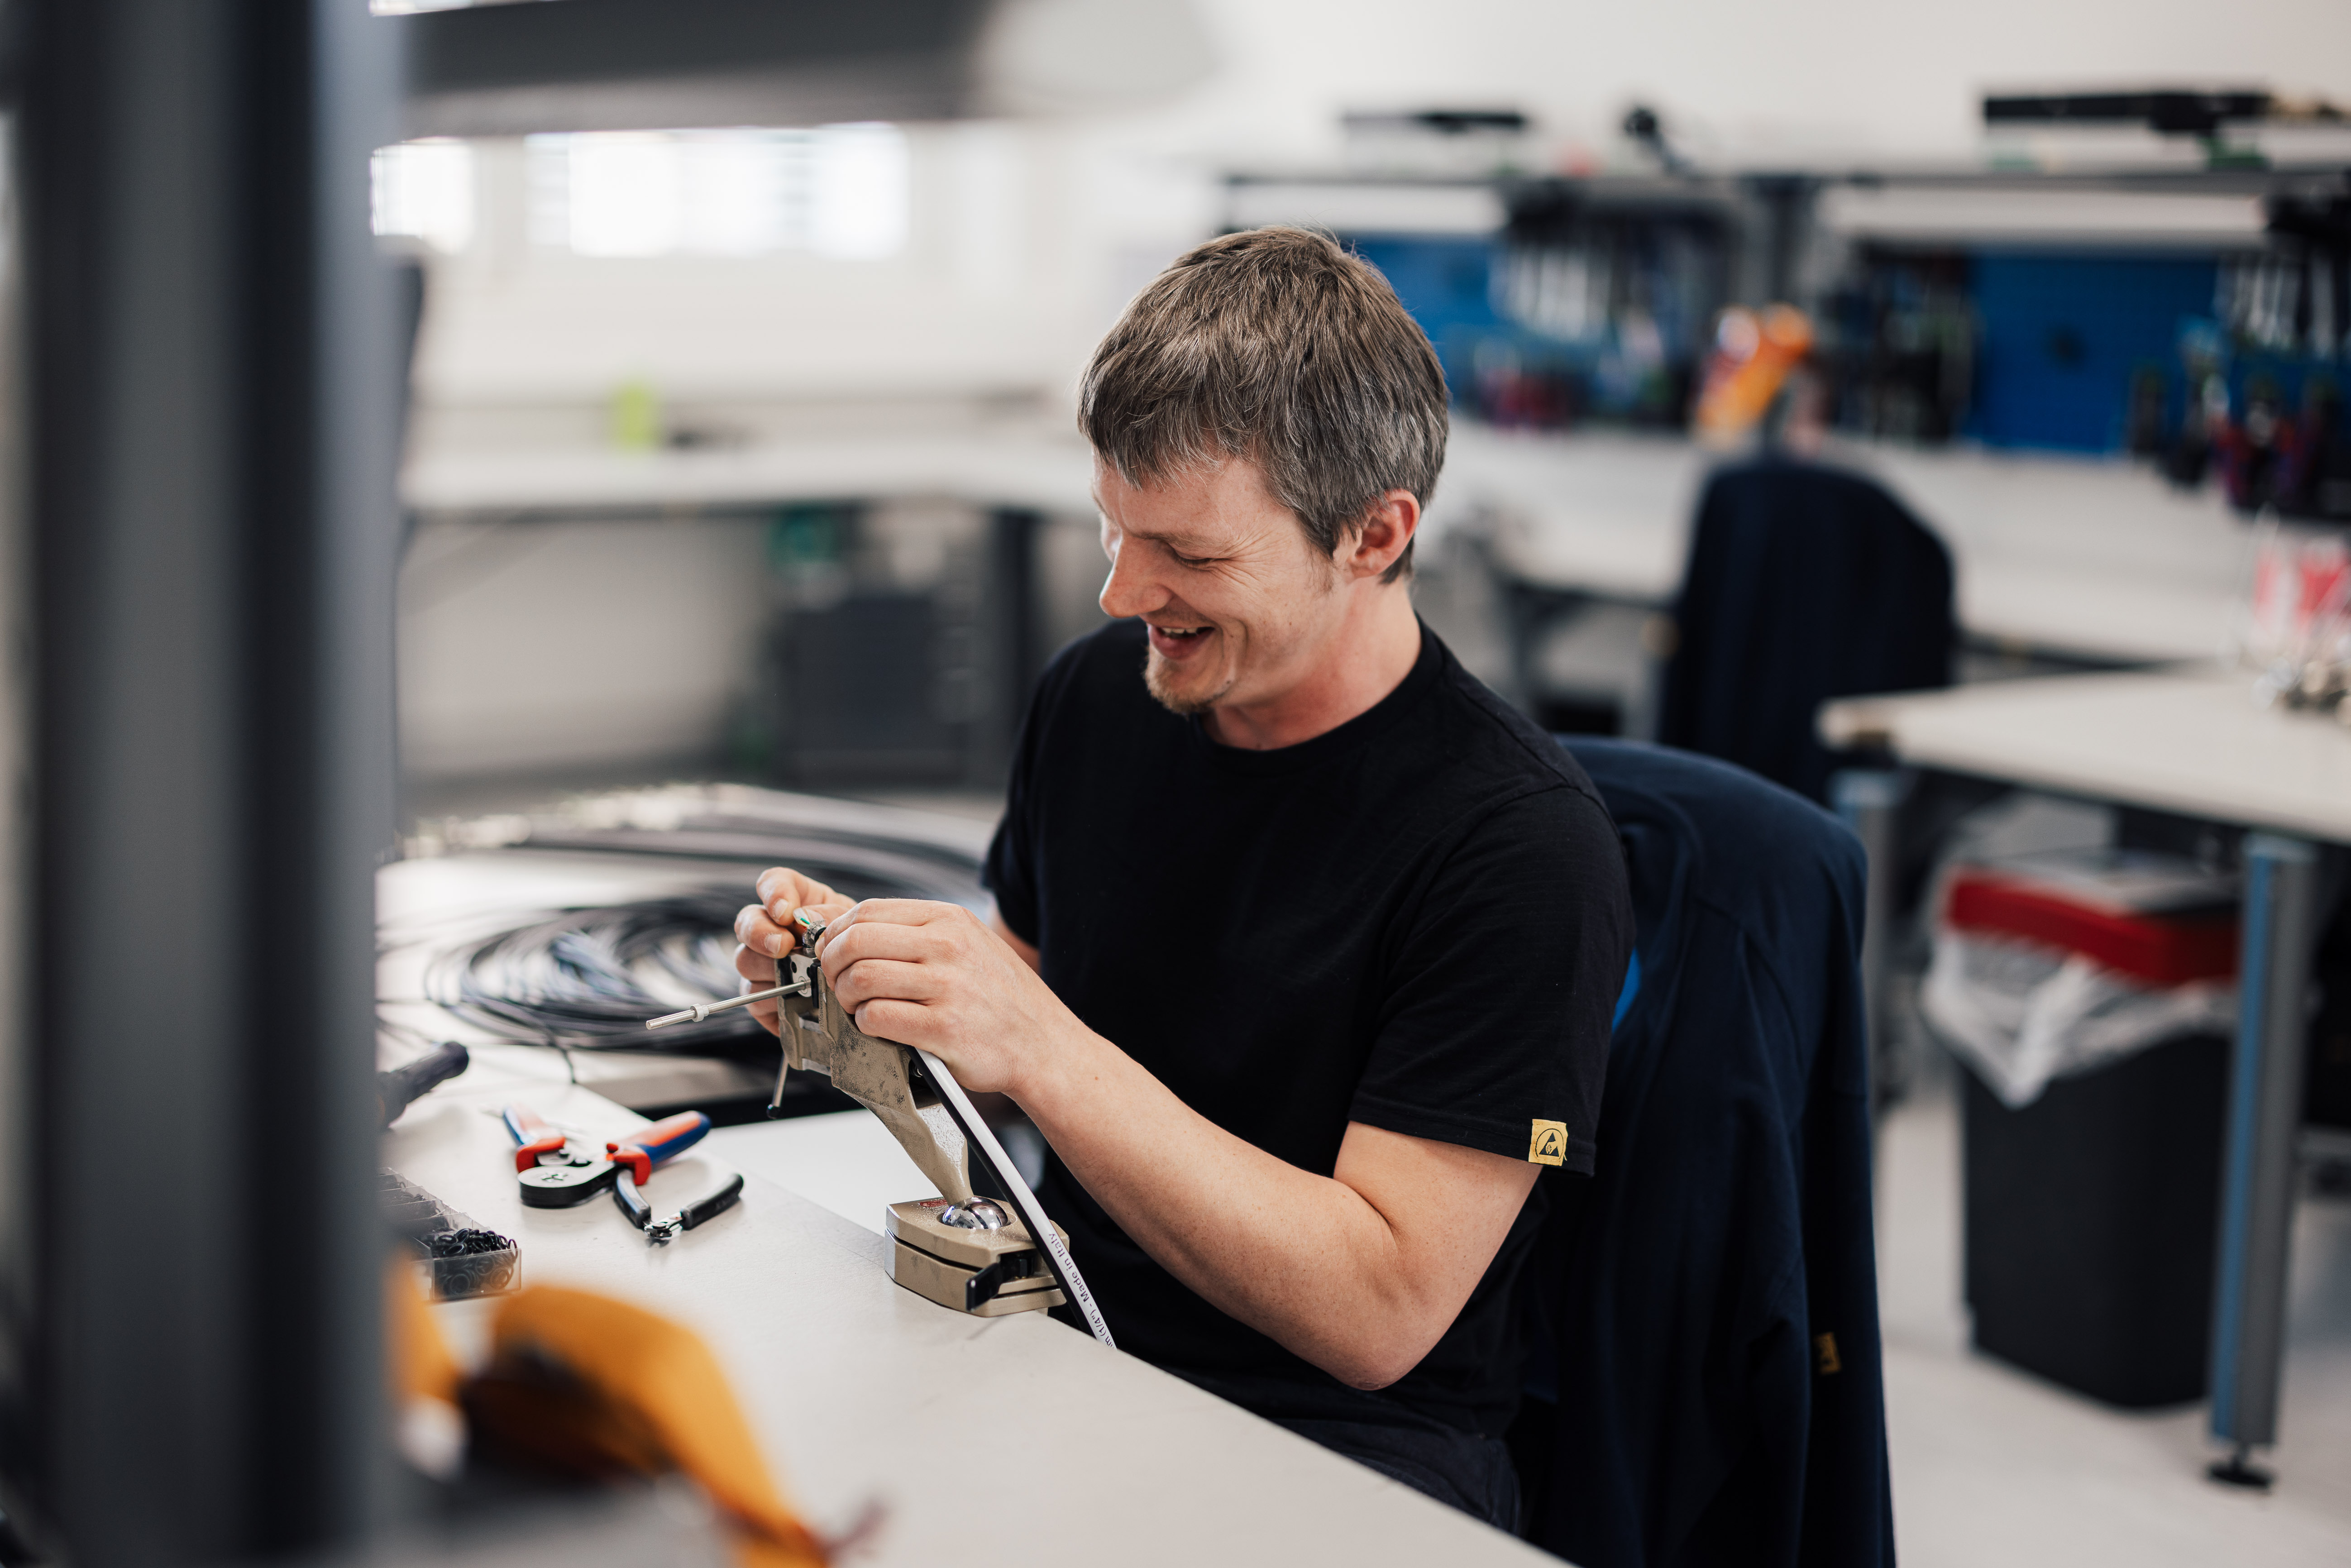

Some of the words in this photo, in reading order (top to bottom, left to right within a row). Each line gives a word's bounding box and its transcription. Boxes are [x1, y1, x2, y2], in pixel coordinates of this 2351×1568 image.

[1049, 1233, 1065, 1257] Italy
[1065, 1258, 1073, 1271] in
[1072, 1271, 1089, 1302] Made
[1090, 1309, 1107, 1336] (1/4")
